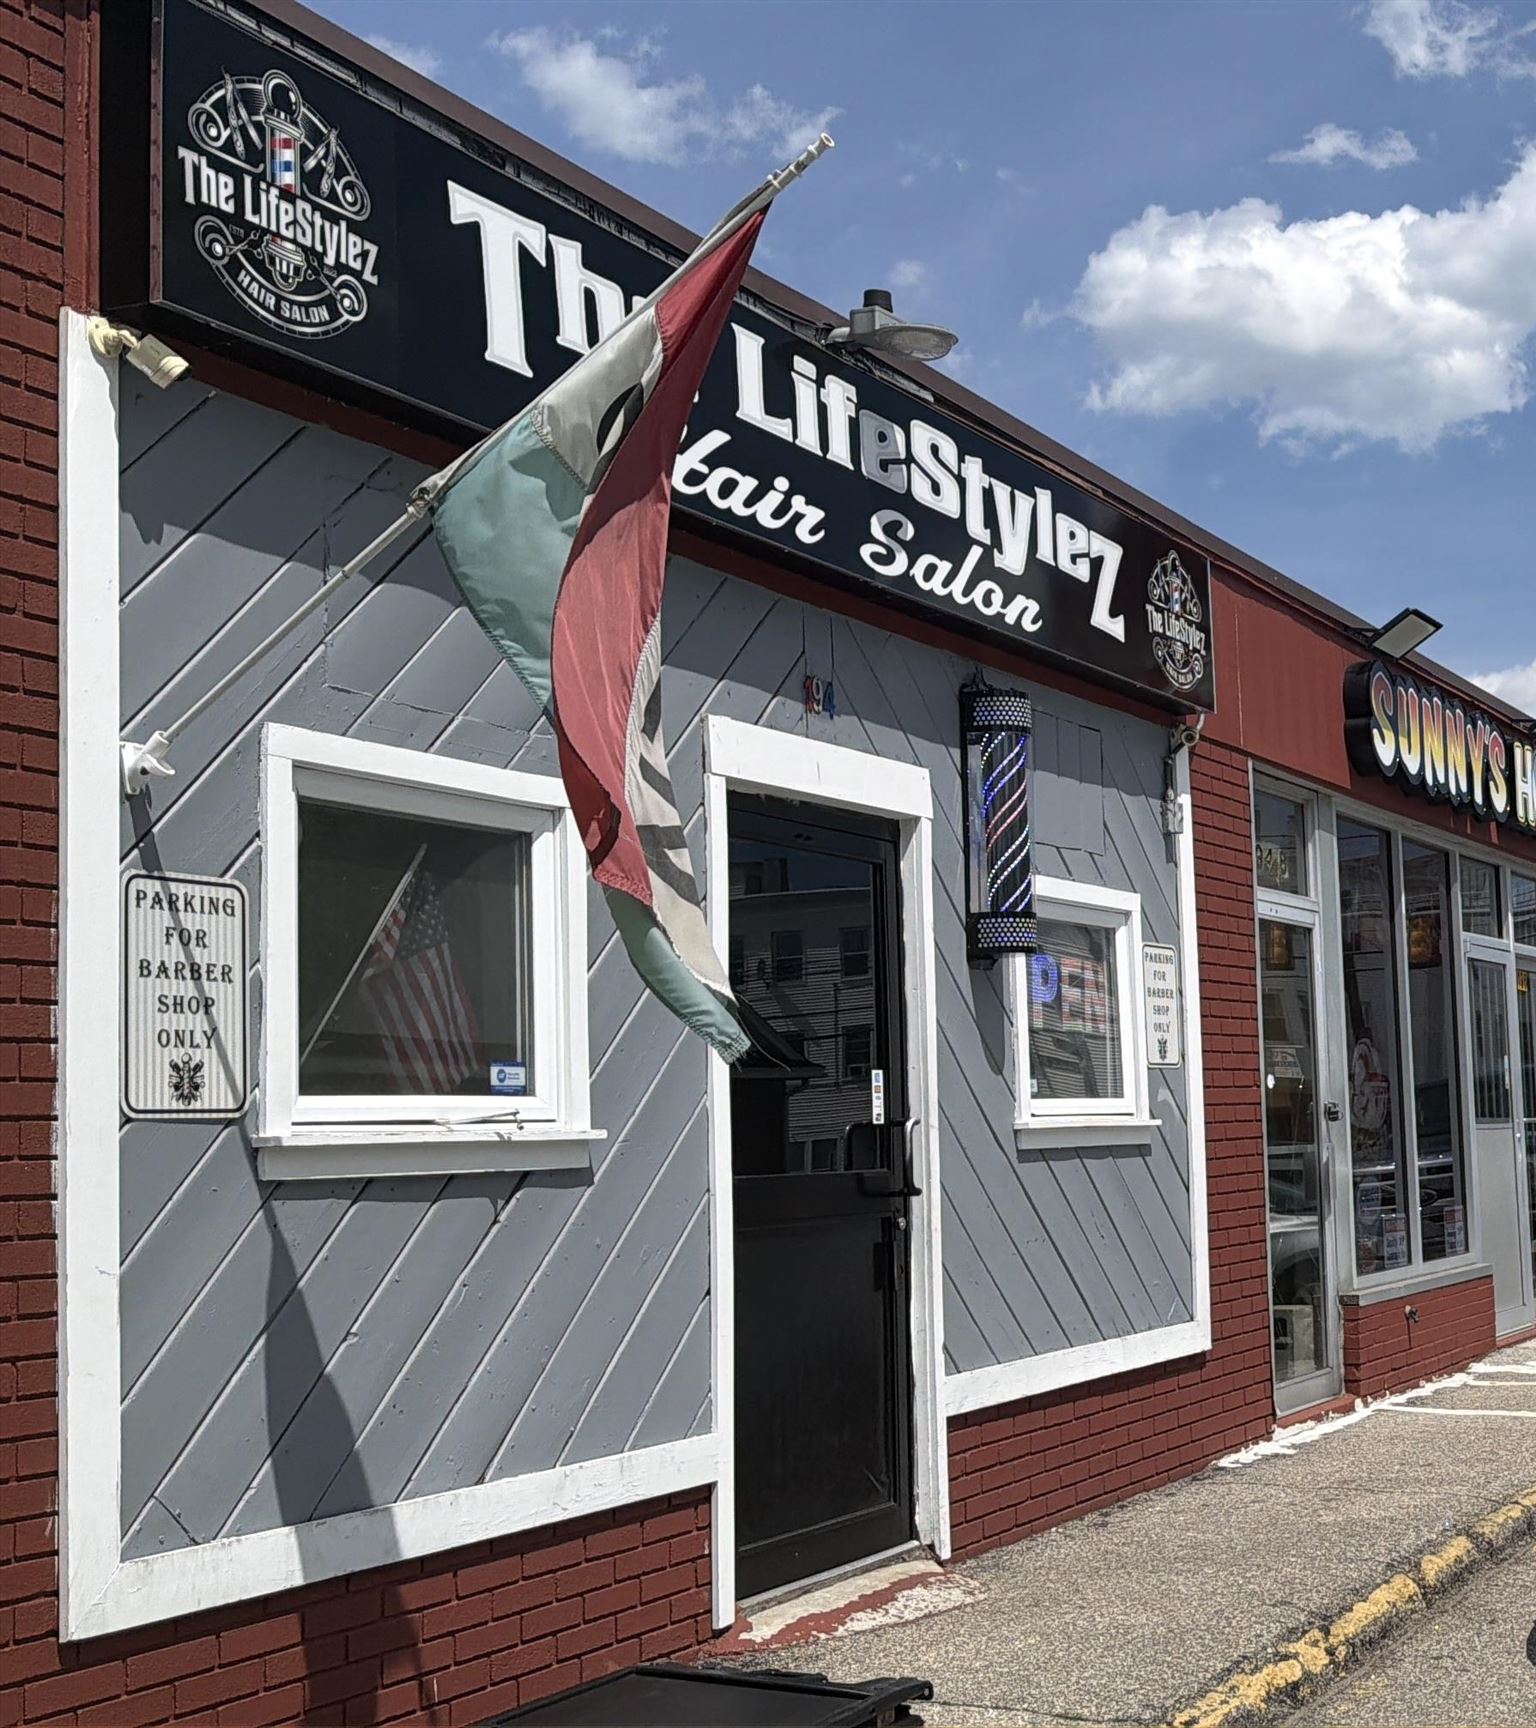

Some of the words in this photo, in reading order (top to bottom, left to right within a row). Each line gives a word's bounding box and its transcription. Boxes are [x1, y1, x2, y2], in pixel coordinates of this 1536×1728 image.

[177, 145, 235, 214] The
[237, 269, 275, 310] HAIR
[280, 301, 331, 323] SALON
[447, 180, 698, 402] Th
[859, 509, 1042, 633] Salon
[1145, 603, 1164, 634] The
[803, 675, 836, 720] 194
[1370, 670, 1508, 815] SUNNY'S
[134, 889, 236, 917] PARKING
[165, 926, 209, 949] FOR
[138, 958, 234, 984] BARBER
[1145, 952, 1174, 965] PARKING
[1153, 970, 1167, 982] FOR
[157, 994, 216, 1016] SHOP
[1032, 953, 1107, 1034] PEN
[1147, 987, 1174, 999] BARBER
[1152, 1004, 1170, 1016] SHOP
[157, 1027, 217, 1049] ONLY
[1153, 1021, 1170, 1034] ONLY
